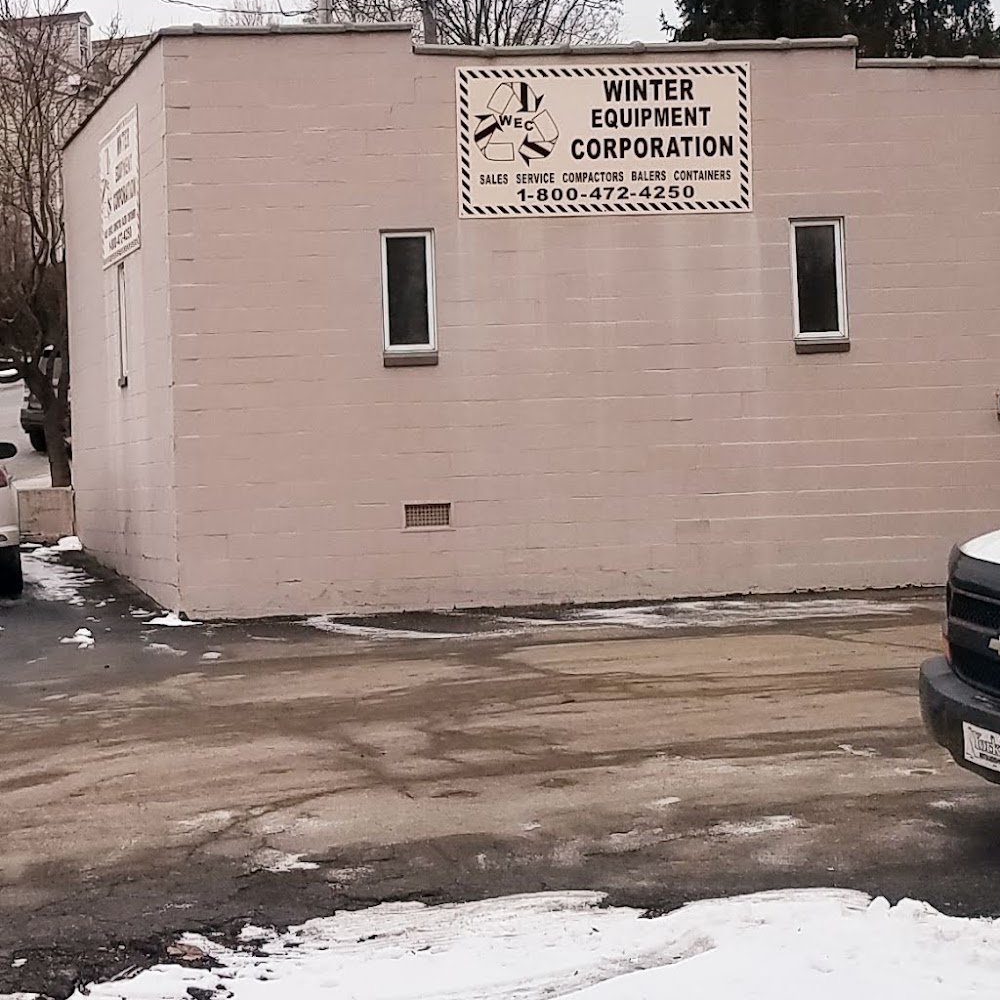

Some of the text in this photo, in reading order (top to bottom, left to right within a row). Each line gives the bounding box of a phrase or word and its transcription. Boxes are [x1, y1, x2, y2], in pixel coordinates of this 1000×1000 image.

[603, 78, 694, 102] WINTER
[498, 114, 534, 132] WEC
[591, 106, 711, 129] EQUIPMENT
[571, 135, 734, 160] CORPORATION
[479, 169, 732, 185] SALES SERVICE COMPACTORS BALERS CONTAINERS
[517, 185, 695, 202] 1-800-472-4250
